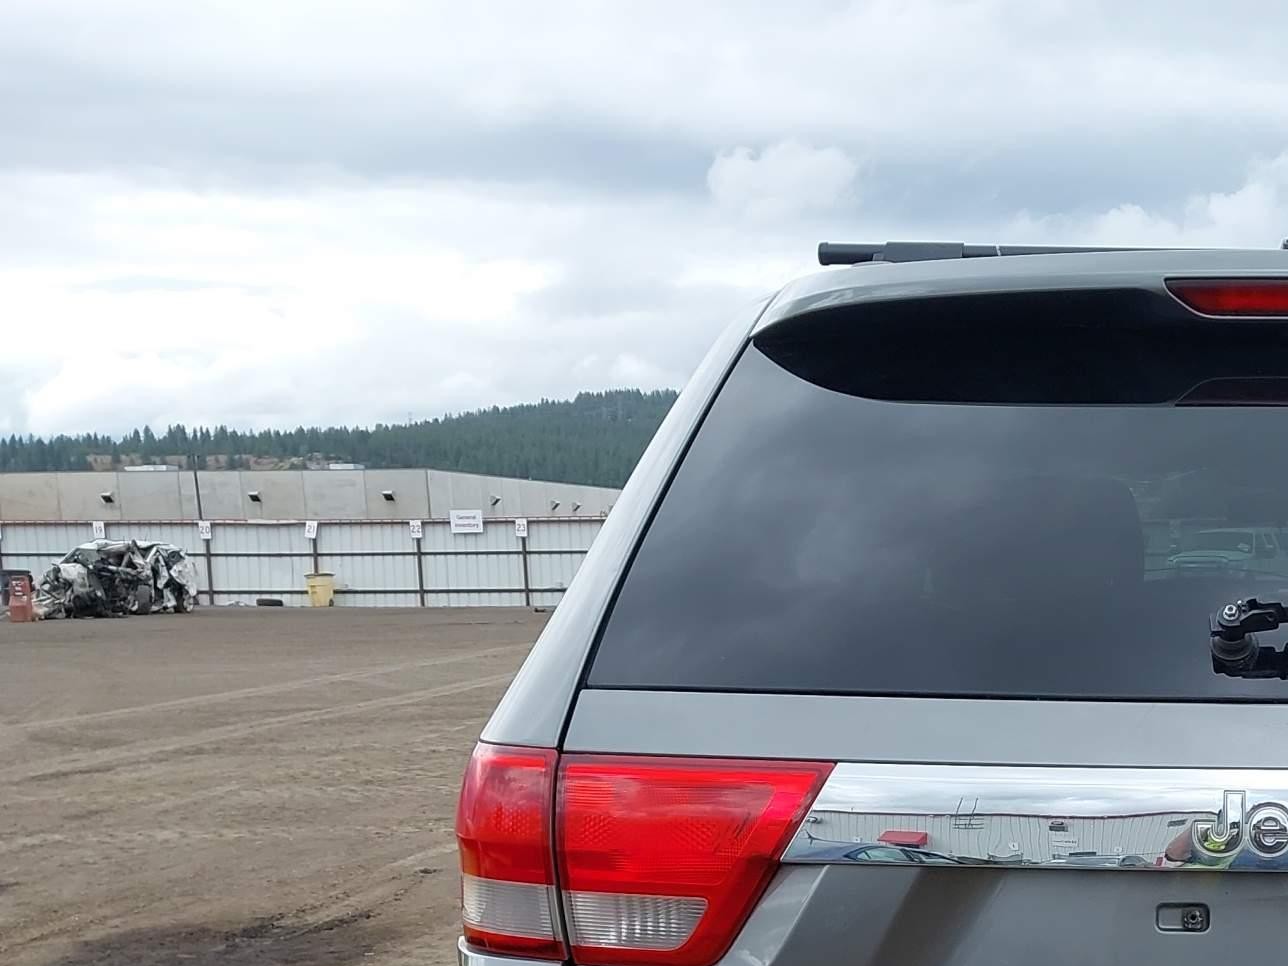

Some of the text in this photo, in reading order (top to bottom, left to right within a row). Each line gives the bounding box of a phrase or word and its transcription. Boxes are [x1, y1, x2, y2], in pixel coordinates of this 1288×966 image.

[95, 525, 103, 534] 19
[200, 526, 210, 534] 20
[306, 525, 316, 533] 21
[410, 525, 421, 533] 22
[516, 523, 526, 532] 23
